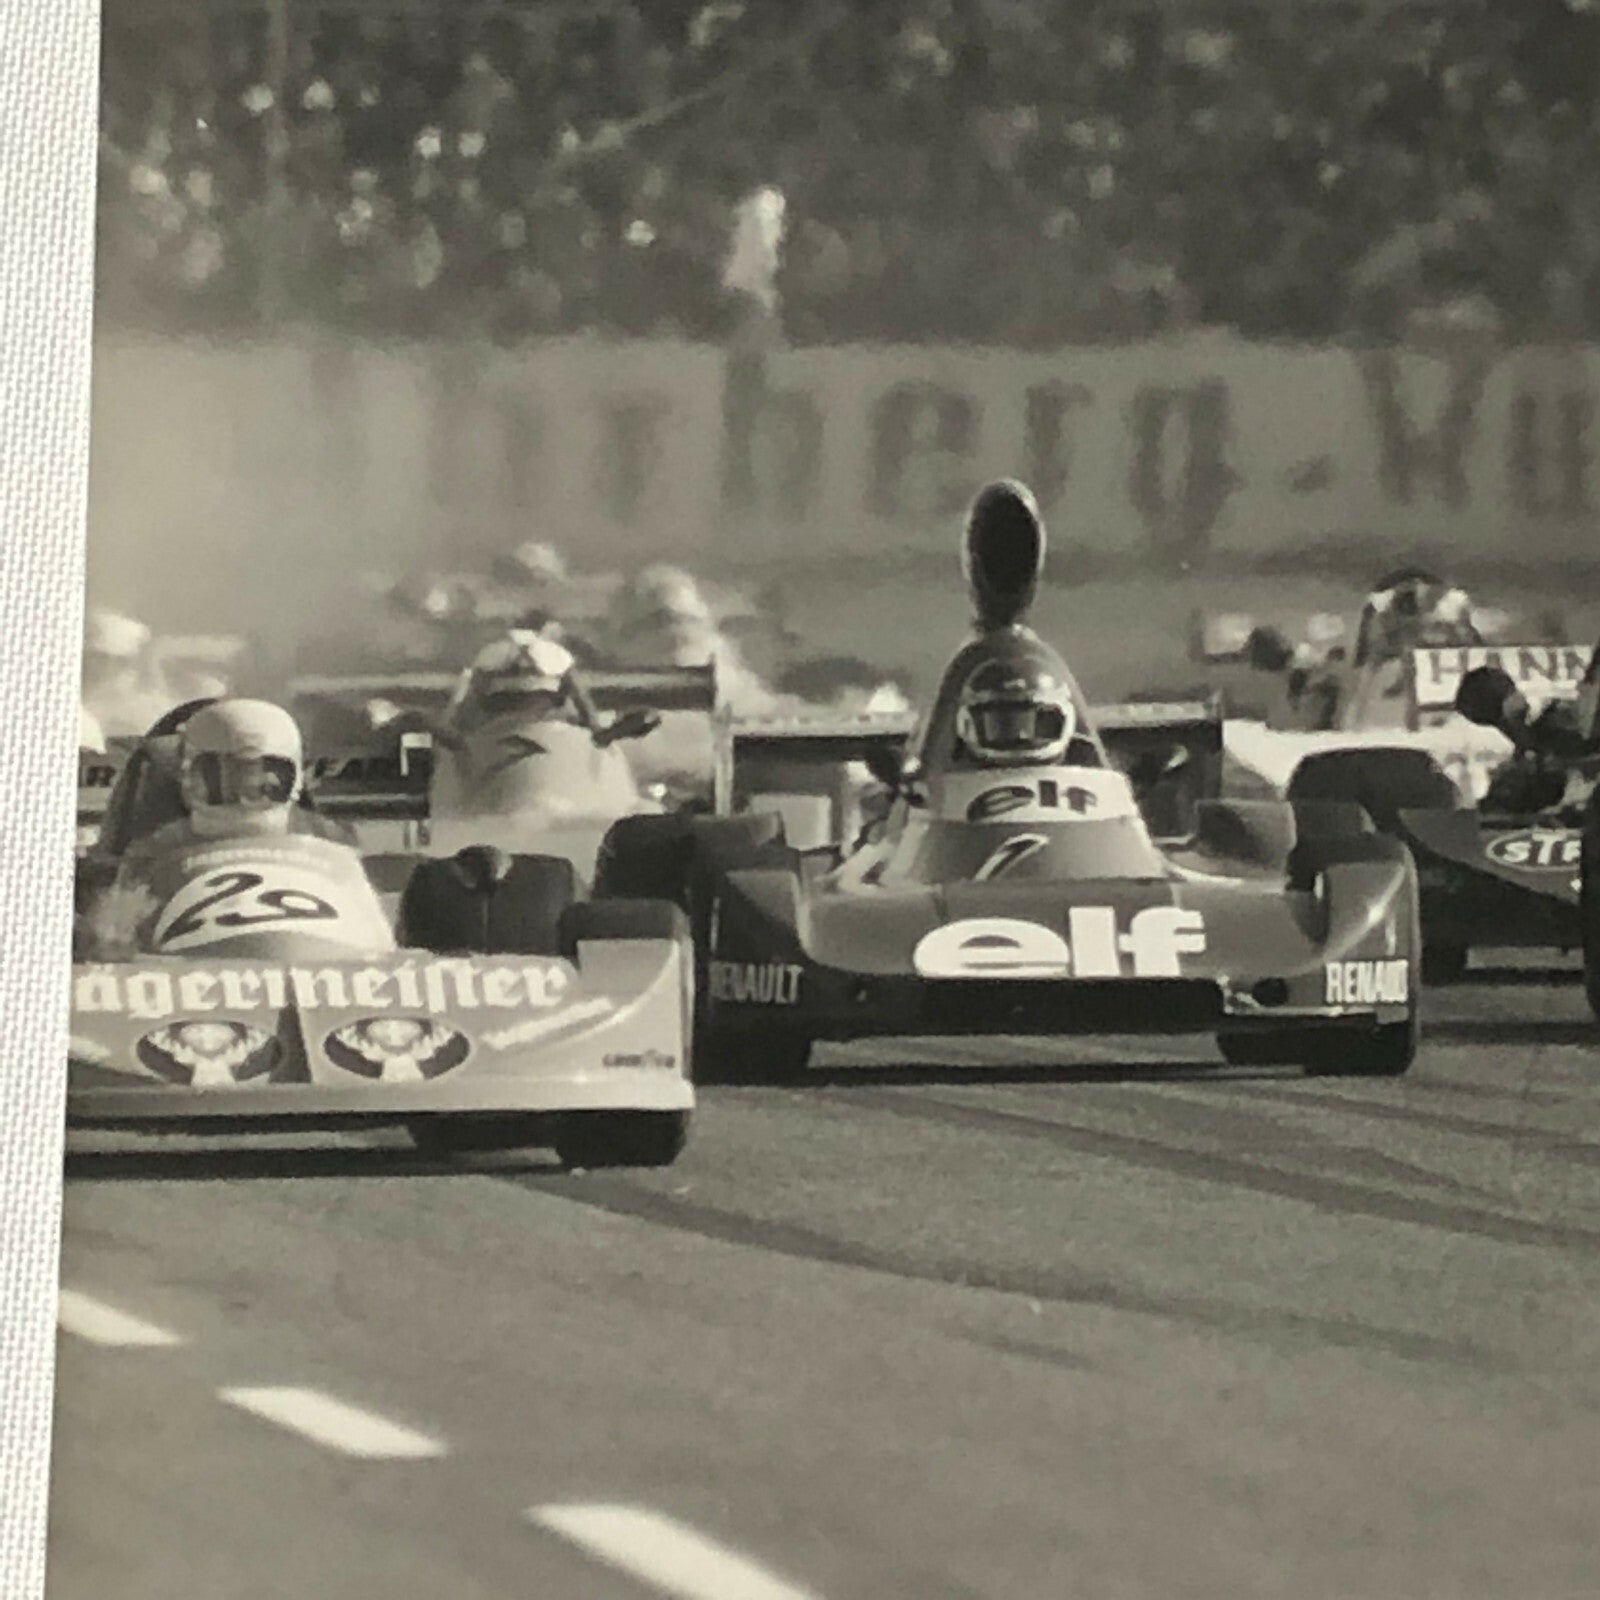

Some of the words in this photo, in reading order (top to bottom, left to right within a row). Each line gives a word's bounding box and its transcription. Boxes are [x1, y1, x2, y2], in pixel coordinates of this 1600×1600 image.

[966, 779, 1098, 822] elf
[913, 906, 1206, 978] elf
[75, 962, 569, 1019] ägermeister
